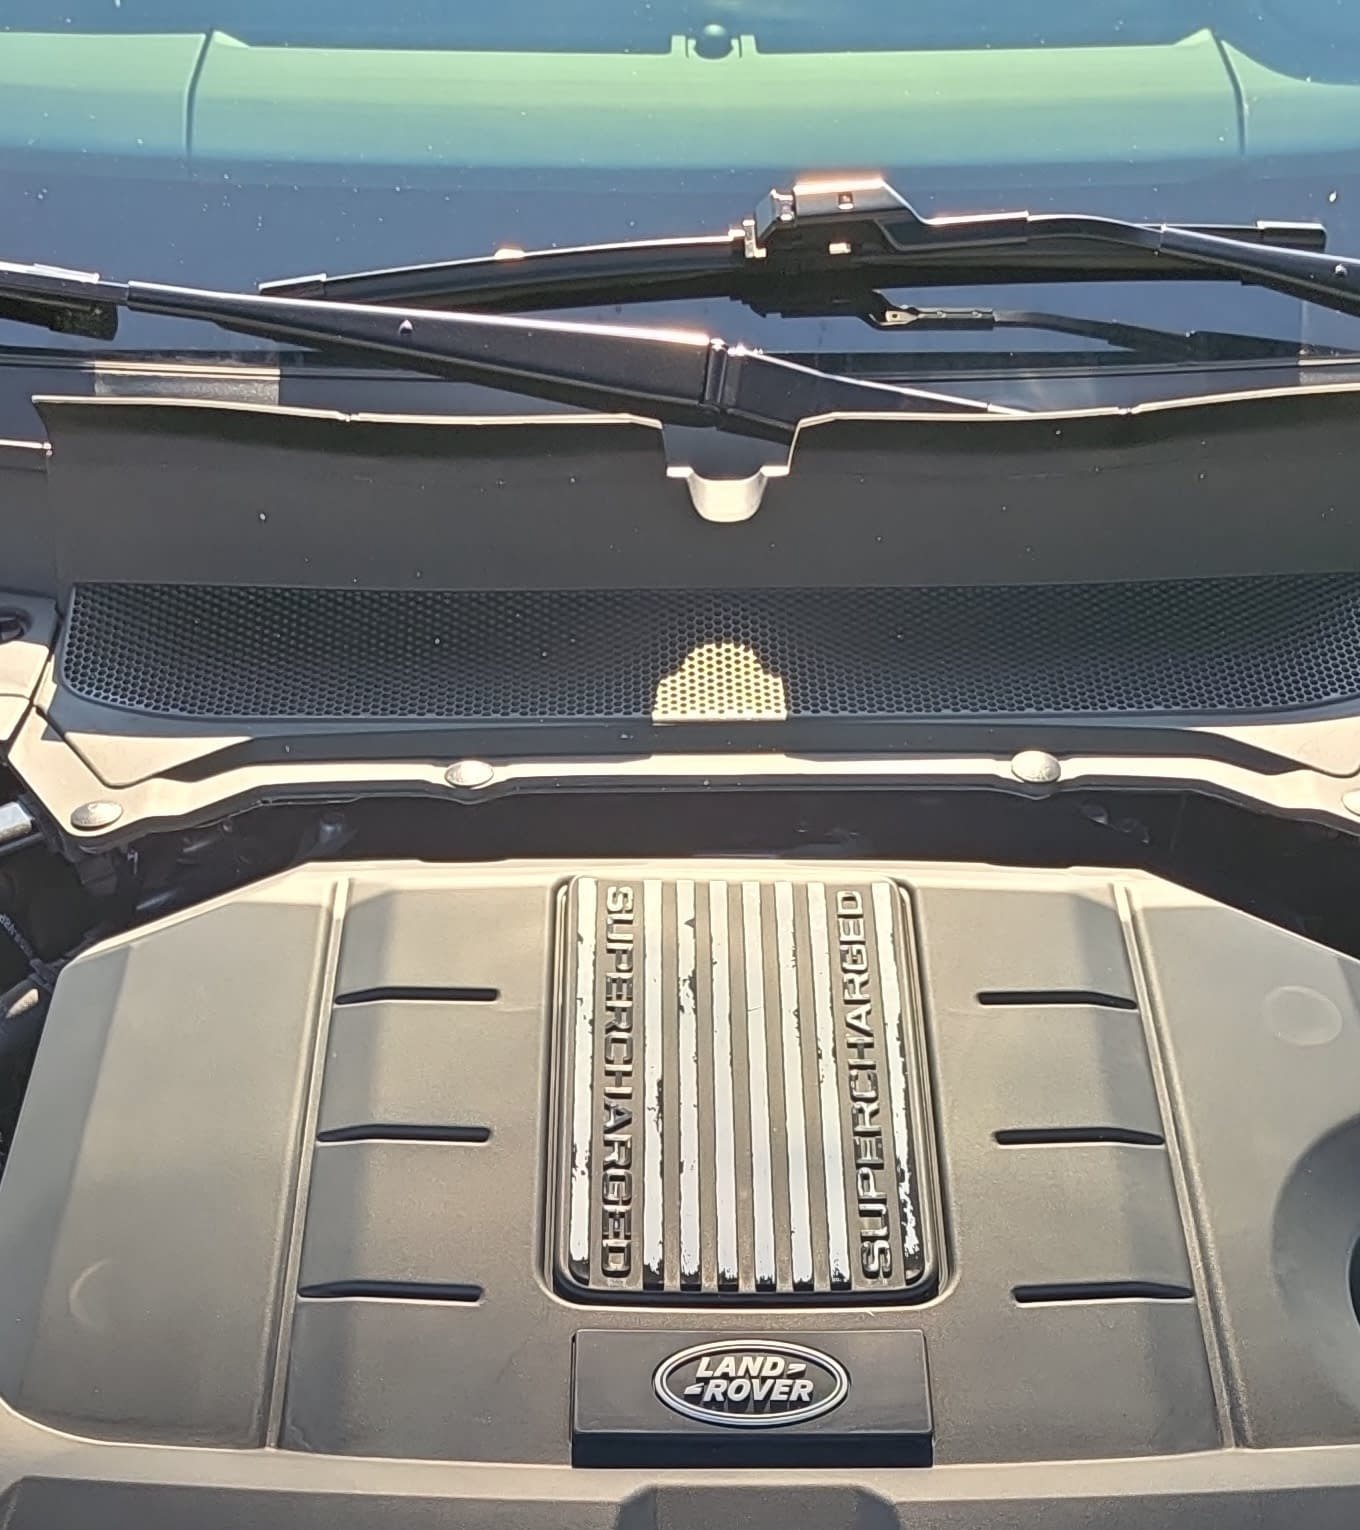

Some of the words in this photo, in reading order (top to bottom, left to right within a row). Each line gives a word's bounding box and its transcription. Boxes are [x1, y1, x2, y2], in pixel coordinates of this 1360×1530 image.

[601, 886, 635, 1279] SUPERCHARGED
[836, 889, 892, 1279] SUPERCHARGED
[695, 1356, 786, 1378] LAND
[703, 1378, 814, 1402] ROVER
